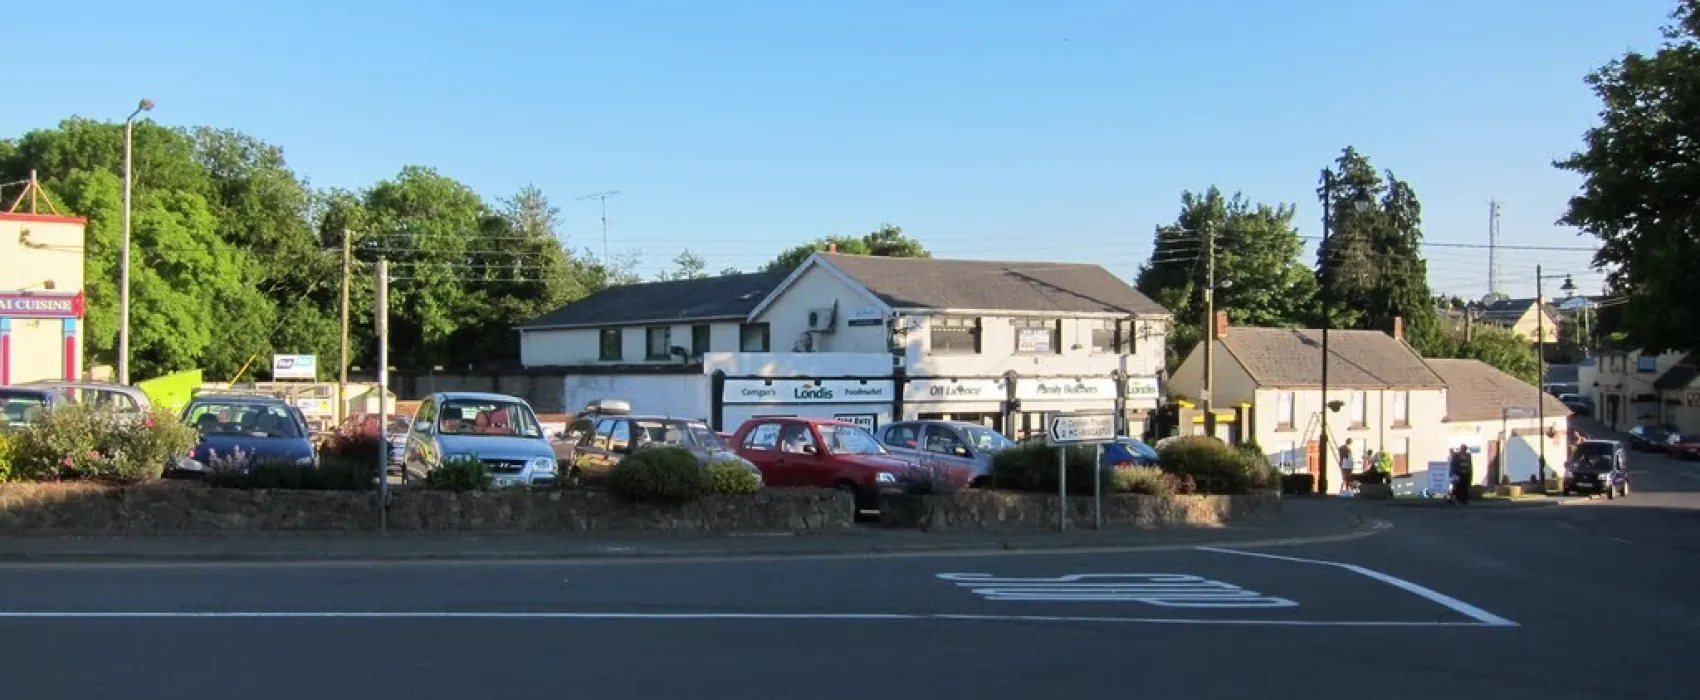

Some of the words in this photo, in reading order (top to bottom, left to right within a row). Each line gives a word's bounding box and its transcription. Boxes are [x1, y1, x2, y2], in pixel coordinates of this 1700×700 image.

[15, 299, 72, 310] CUISINE
[794, 387, 834, 399] Londis
[844, 388, 882, 396] Foodmarket
[935, 572, 1300, 607] STOP
